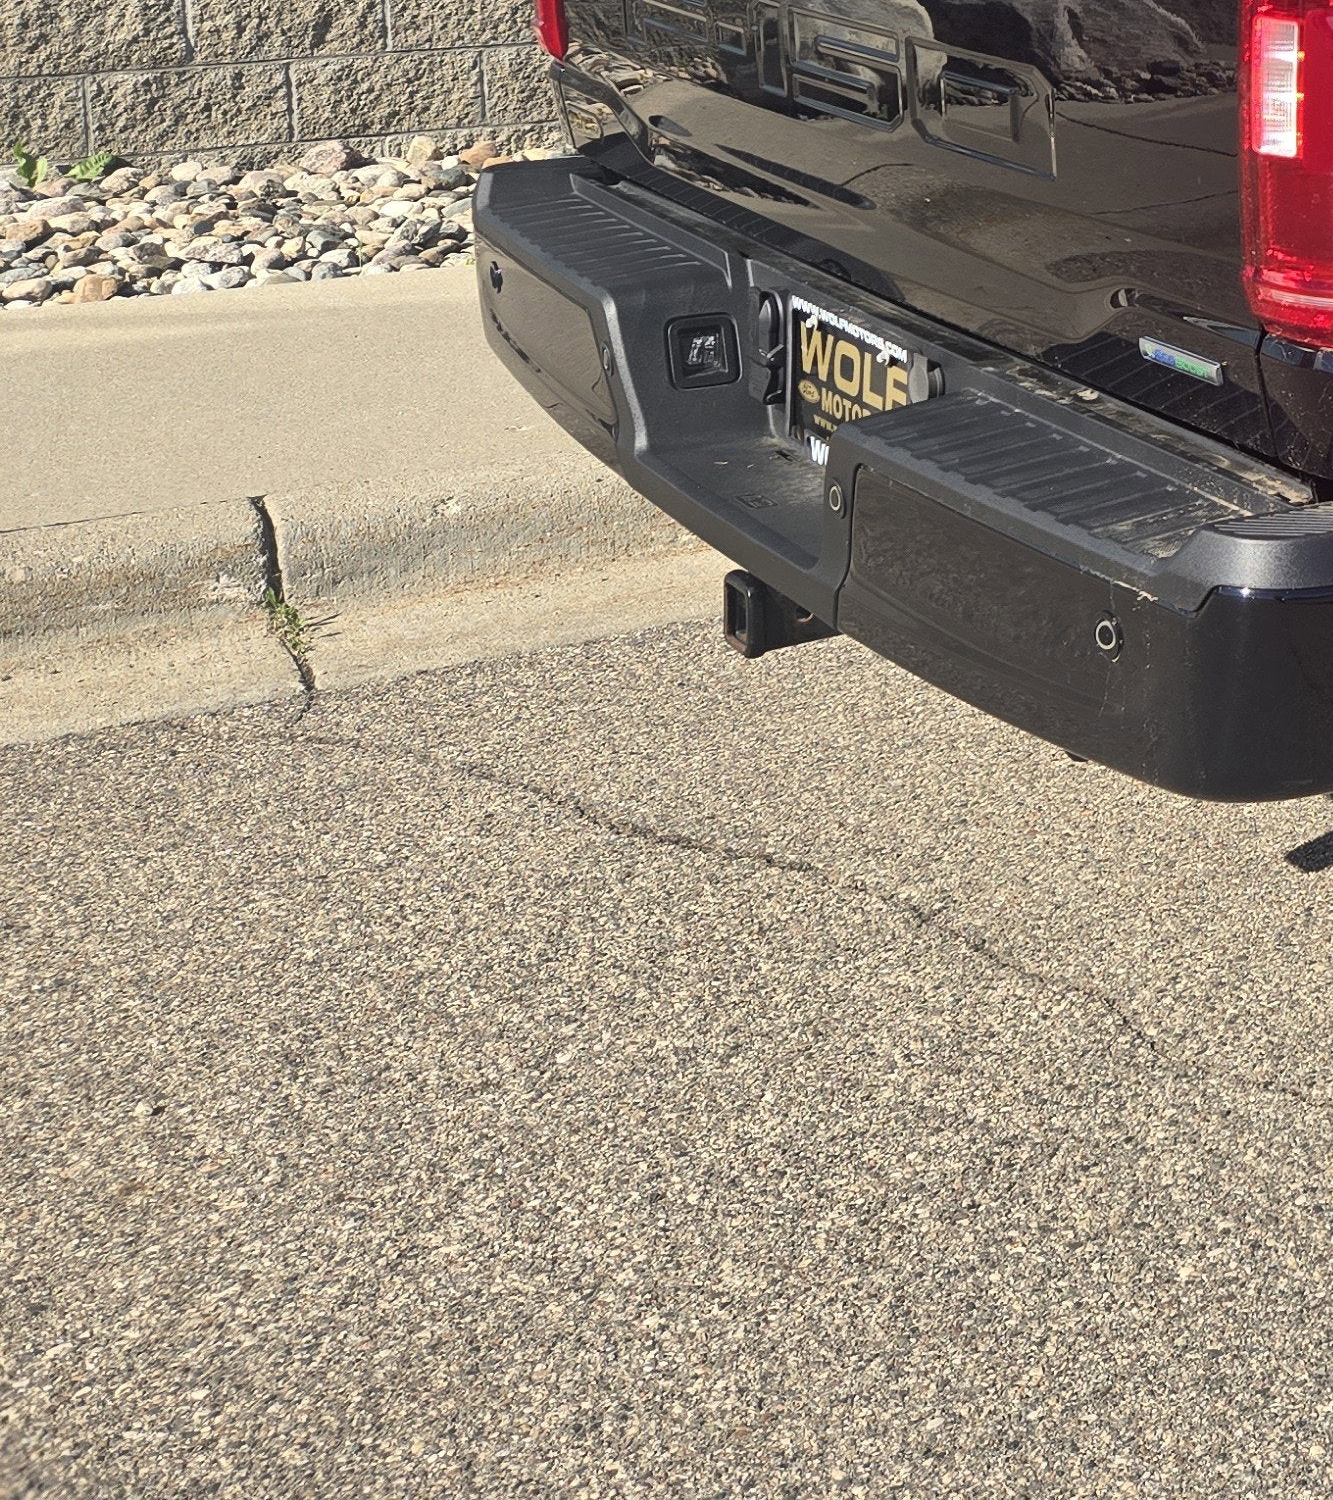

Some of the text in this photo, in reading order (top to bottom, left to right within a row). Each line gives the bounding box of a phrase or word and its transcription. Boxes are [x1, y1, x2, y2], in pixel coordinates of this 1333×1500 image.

[791, 295, 908, 364] WWW.WOLFMOTORS.COM
[800, 320, 908, 411] WOLF
[821, 387, 872, 422] MOTO
